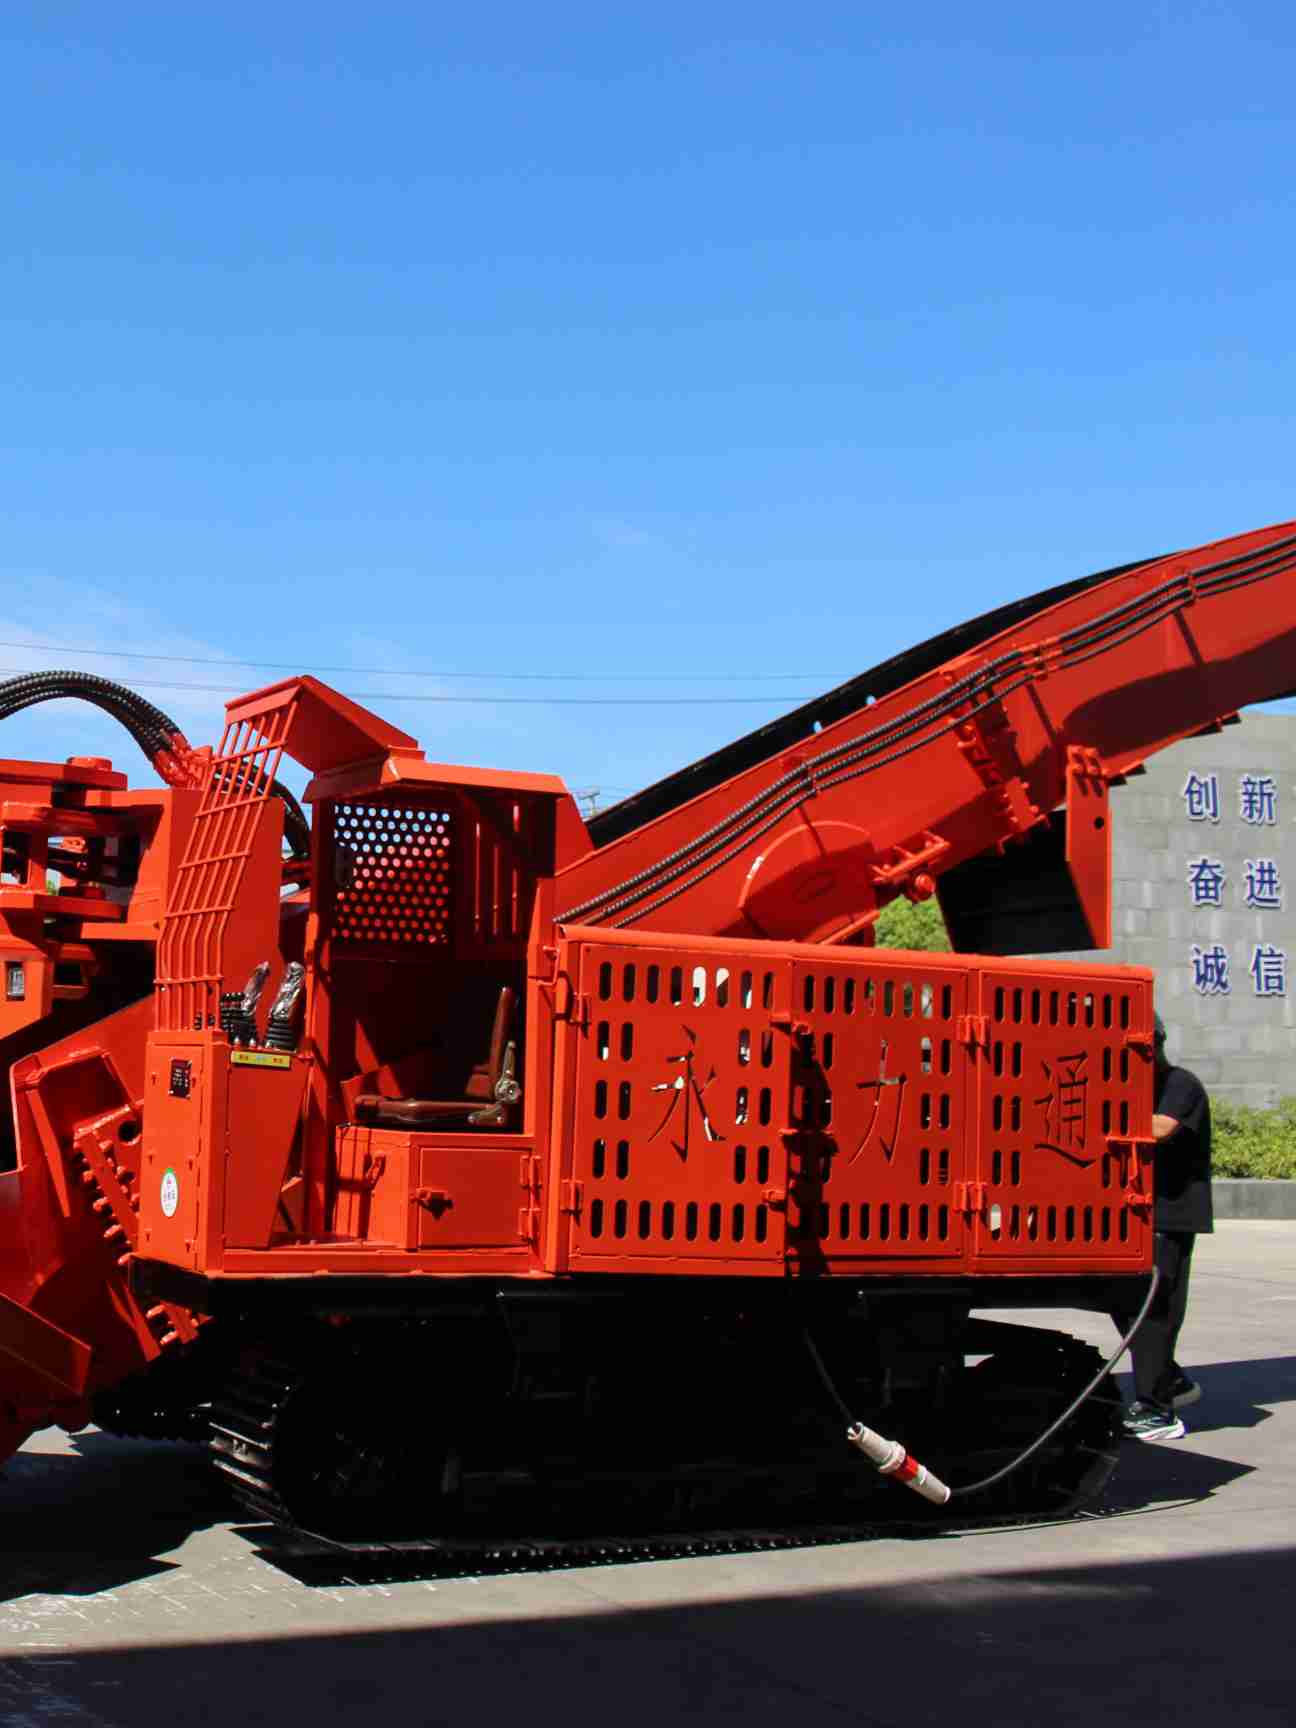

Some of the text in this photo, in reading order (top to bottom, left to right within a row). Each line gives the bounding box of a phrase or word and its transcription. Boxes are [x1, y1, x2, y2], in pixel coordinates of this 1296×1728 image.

[1184, 775, 1276, 821] 创新
[1190, 858, 1280, 904] 奋进
[1194, 946, 1286, 993] 诚信
[648, 1025, 1096, 1168] 永力通
